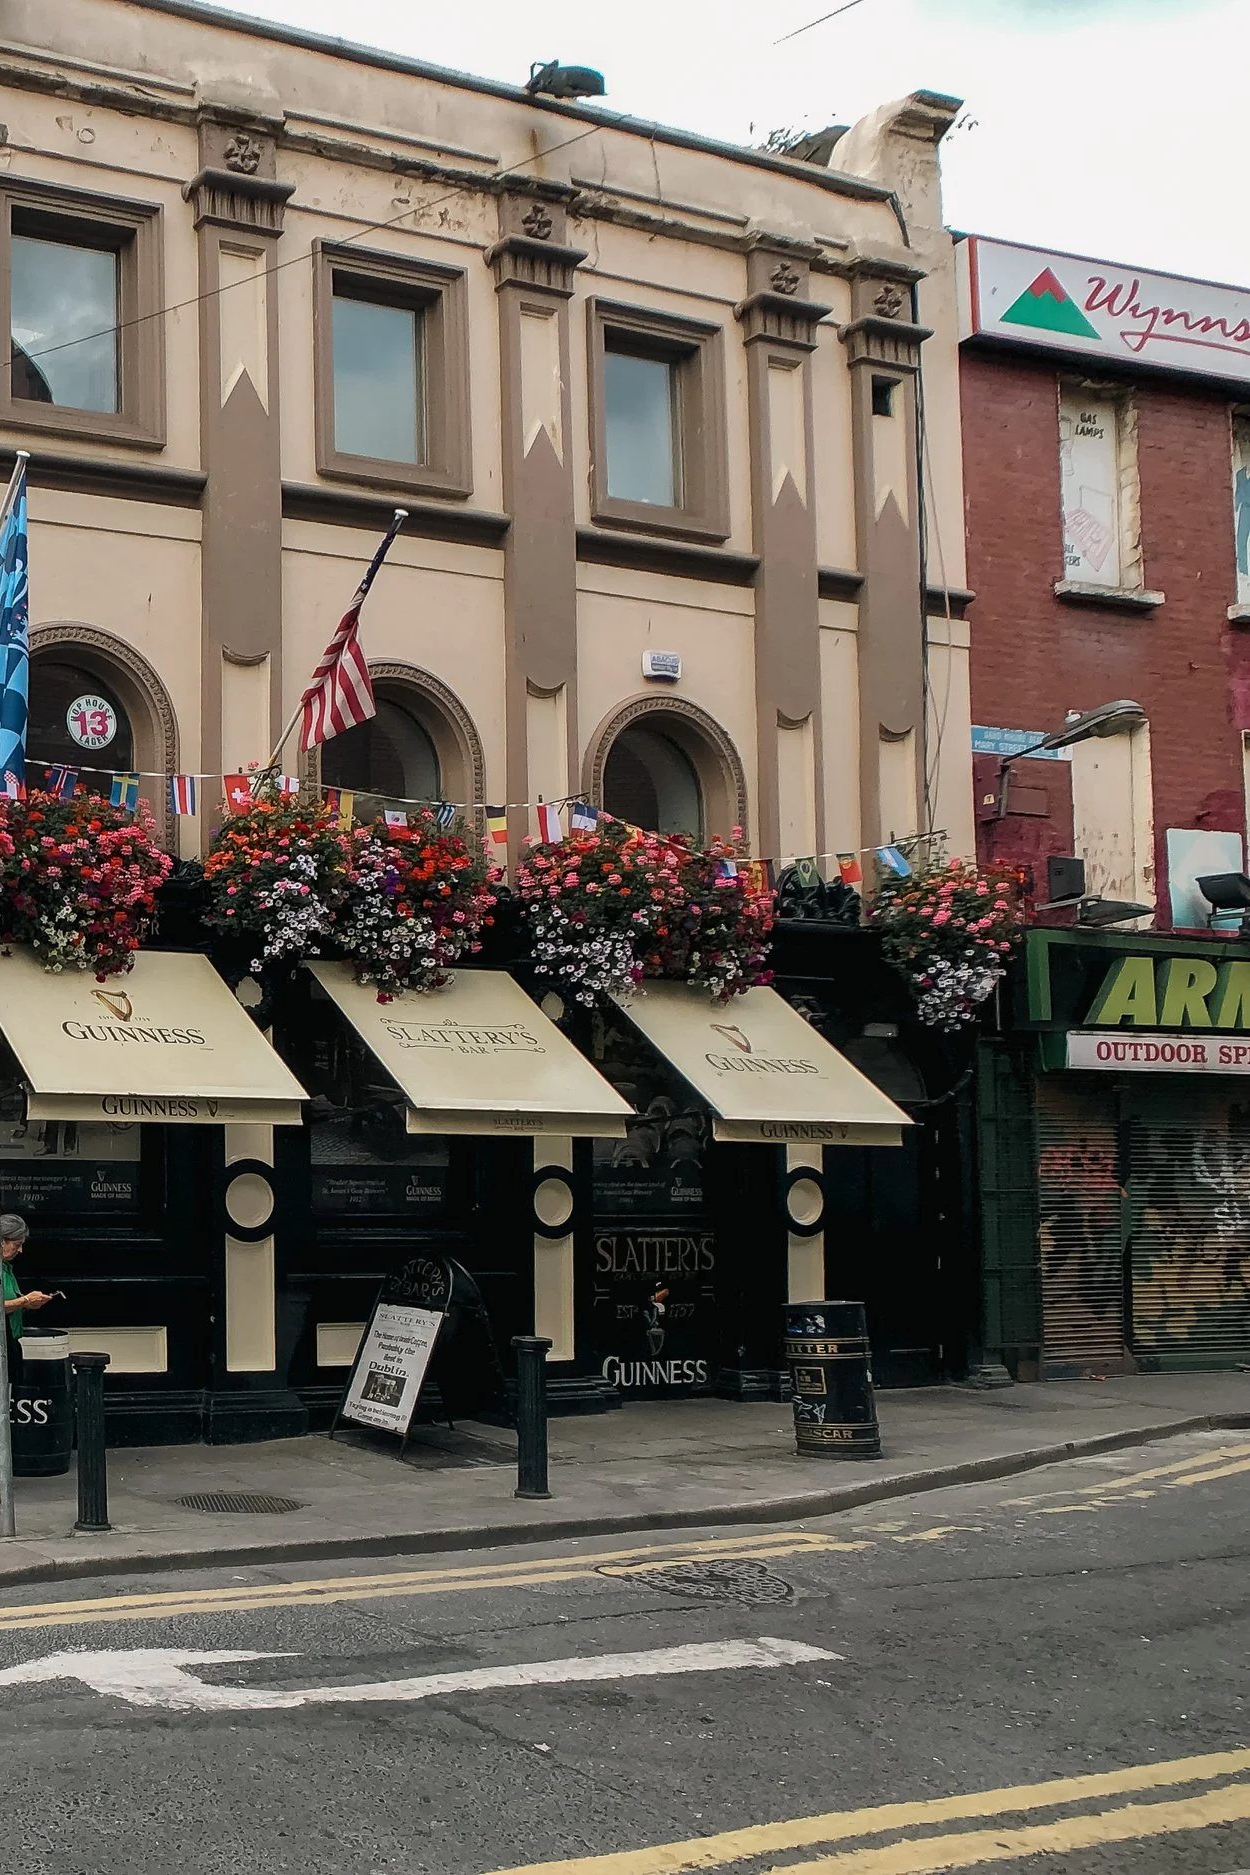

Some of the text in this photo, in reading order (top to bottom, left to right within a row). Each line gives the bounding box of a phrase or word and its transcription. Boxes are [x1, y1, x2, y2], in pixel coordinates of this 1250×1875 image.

[1080, 412, 1097, 424] GAS
[1075, 424, 1104, 439] LAMPS
[652, 655, 680, 666] ABACUS
[70, 702, 82, 721] HOP
[74, 710, 109, 736] 13
[62, 1021, 206, 1045] GUINNESS
[386, 1026, 538, 1045] SLATTERY'S
[458, 1045, 490, 1055] BAR
[1097, 1040, 1250, 1065] OUTDOOR SP
[705, 1053, 820, 1074] GUINNESS
[101, 1096, 199, 1118] GUINNESS
[760, 1122, 834, 1139] GUINNESS
[90, 1181, 132, 1193] GUINNESS
[406, 1184, 442, 1196] GUINNESS
[595, 1236, 716, 1273] SLATTERYS
[369, 1361, 410, 1378] Dublin.
[602, 1356, 708, 1387] GUINNESS
